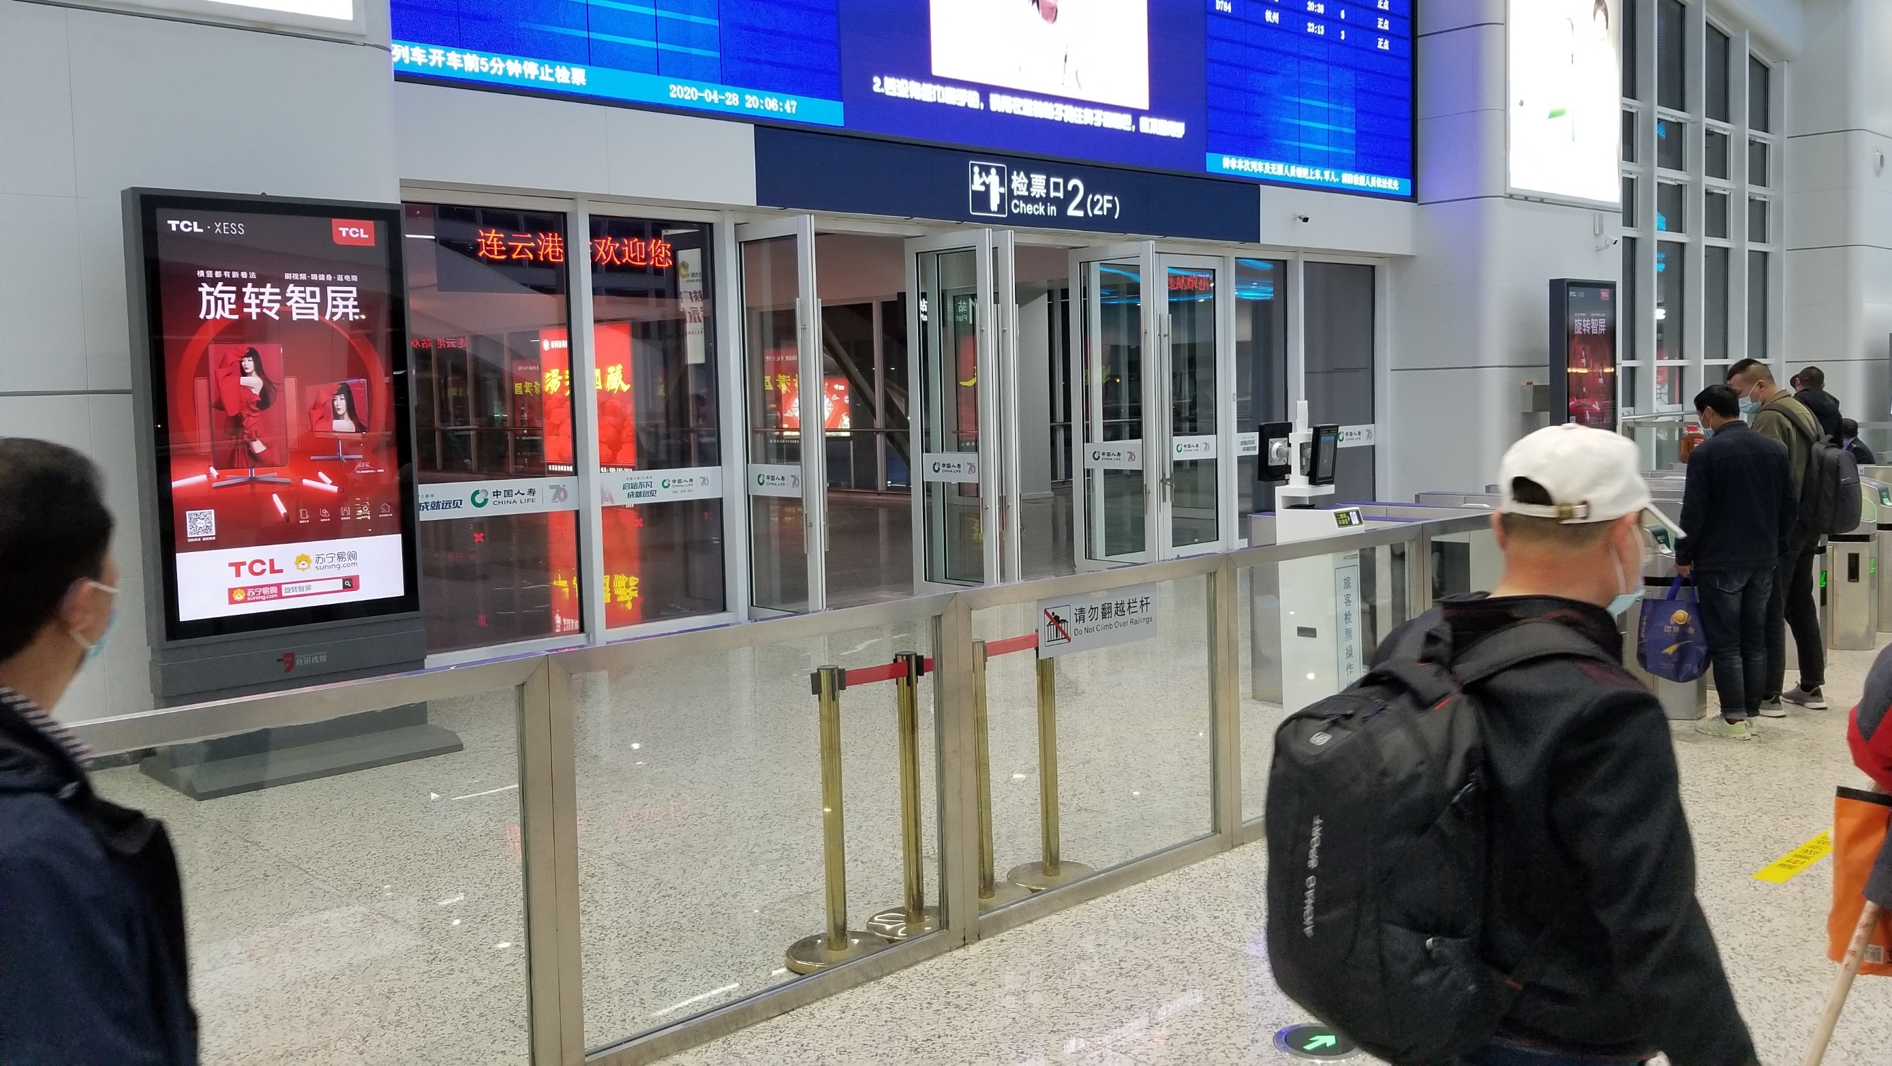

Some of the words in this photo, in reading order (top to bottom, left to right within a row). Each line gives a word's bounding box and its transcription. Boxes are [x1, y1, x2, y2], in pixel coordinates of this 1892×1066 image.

[1377, 18, 1389, 30] 正点
[1377, 38, 1389, 50] 正点
[391, 44, 587, 86] 列车开车前5分钟停止检票
[669, 84, 740, 107] 2020-04-28
[744, 94, 798, 114] 20:06:47
[1011, 171, 1064, 199] 检票口
[1067, 178, 1085, 217] 2
[1086, 193, 1120, 219] (2F)
[1011, 200, 1045, 216] Check
[1047, 203, 1057, 217] in
[167, 220, 204, 233] TCL
[214, 222, 245, 235] XESS
[338, 226, 369, 239] TCL
[197, 282, 361, 322] 旋转智屏
[1574, 317, 1607, 335] 旋转智屏
[492, 488, 537, 499] 中国人寿
[419, 499, 463, 512] 成就远见
[314, 551, 358, 565] 苏宁易购
[315, 561, 358, 571] suning.com
[228, 559, 284, 578] TCL
[247, 586, 278, 597] 苏宁易购
[247, 593, 278, 601] suning.com
[1074, 596, 1151, 625] 请勿翻越栏杆
[1074, 627, 1082, 636] Do
[1084, 626, 1095, 634] Not
[1096, 622, 1113, 632] Climb
[1114, 620, 1129, 629] Over
[1130, 615, 1153, 626] Railings
[1343, 576, 1354, 688] 旅客检票操作
